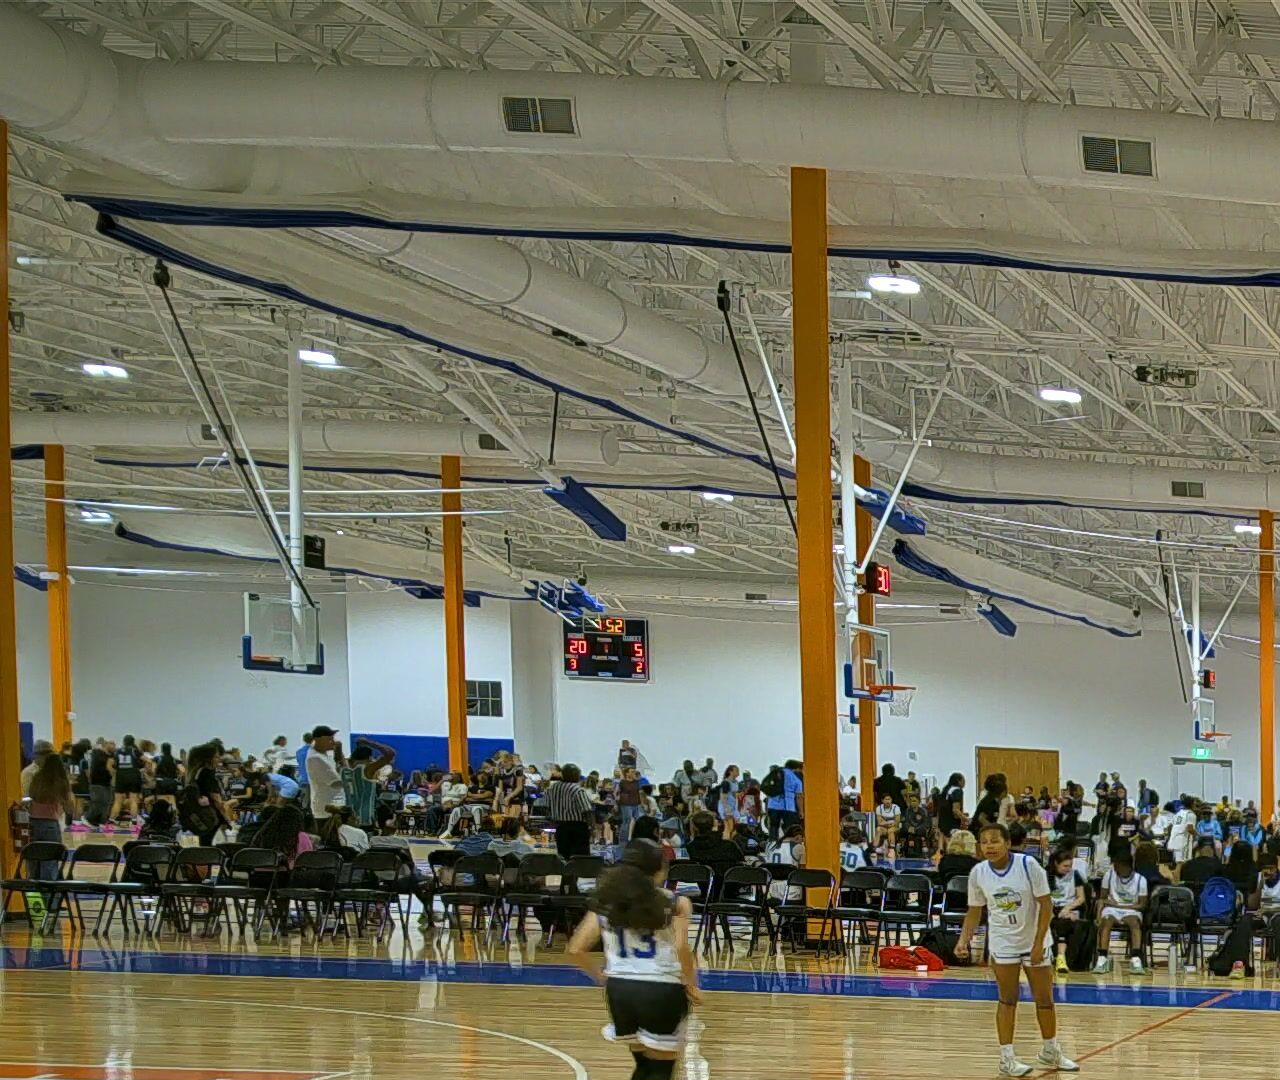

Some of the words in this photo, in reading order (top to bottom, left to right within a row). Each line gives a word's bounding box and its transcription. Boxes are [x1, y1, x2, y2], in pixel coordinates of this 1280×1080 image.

[569, 640, 587, 654] 20
[634, 643, 643, 657] 5
[570, 659, 577, 670] 3
